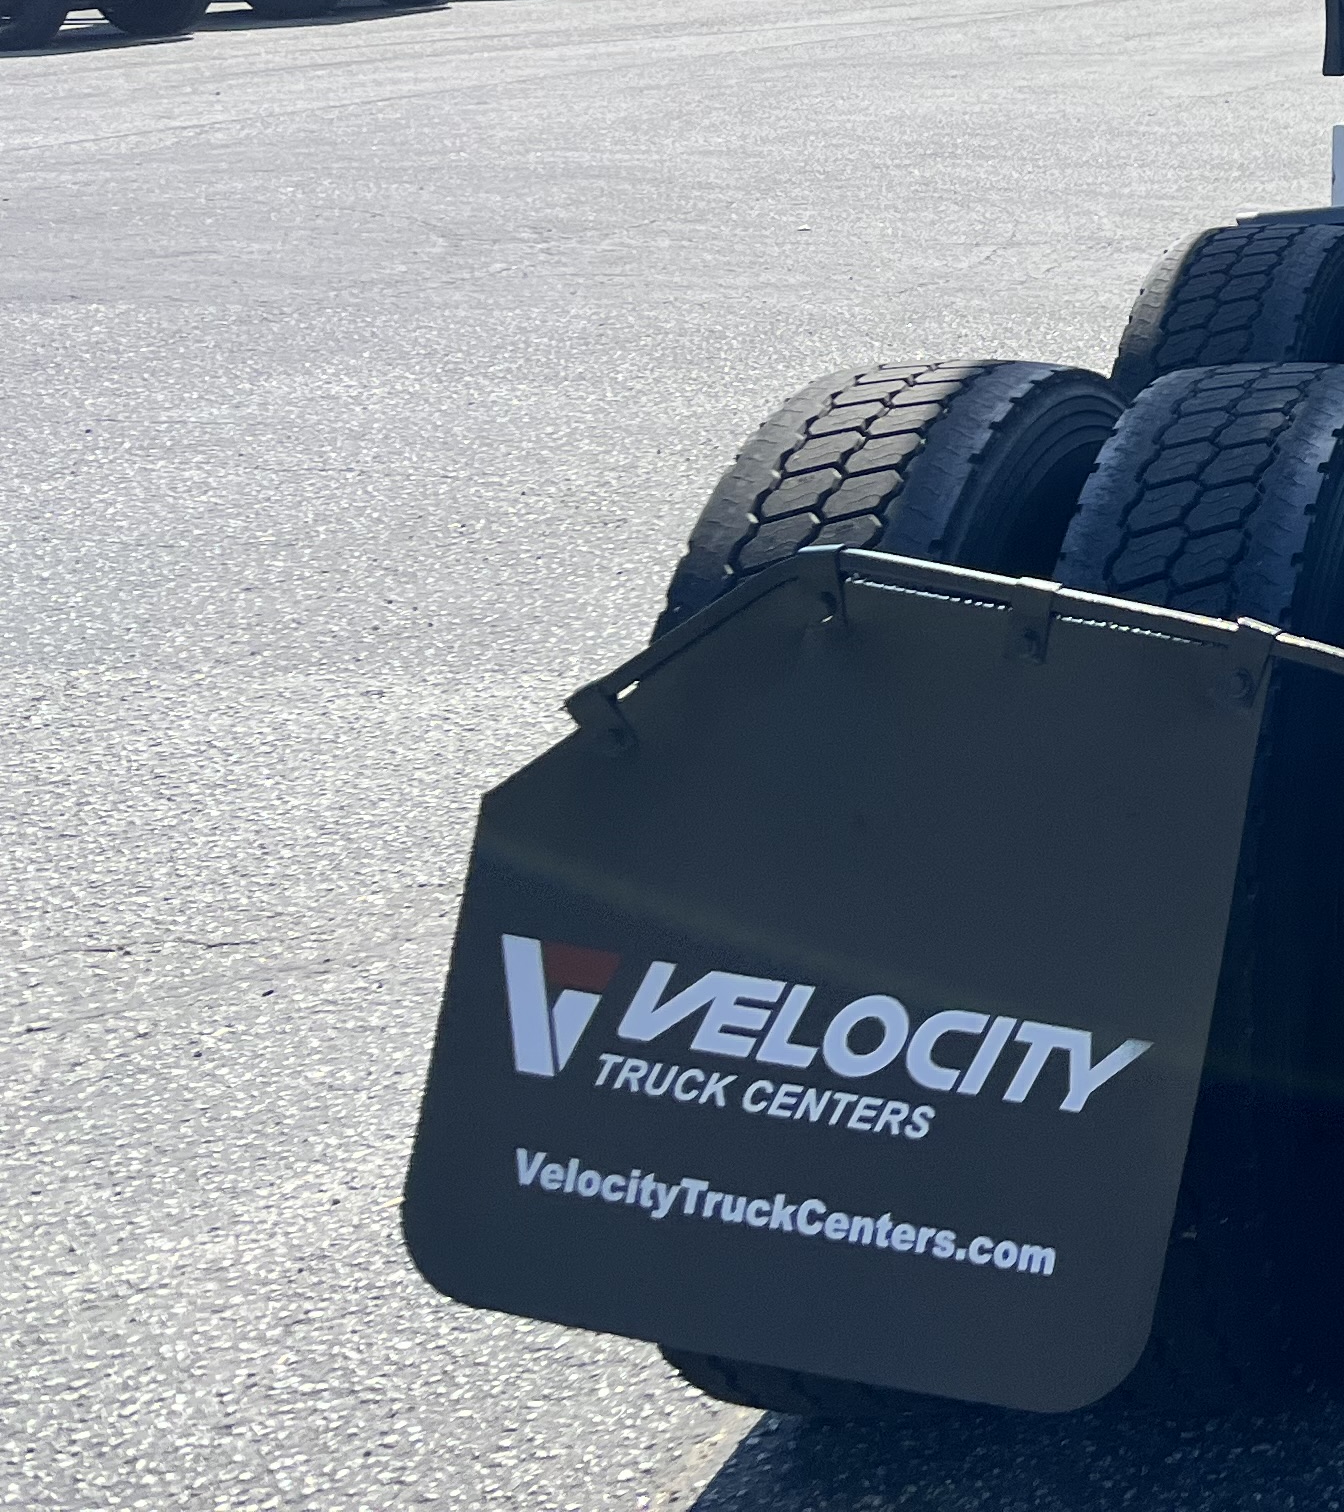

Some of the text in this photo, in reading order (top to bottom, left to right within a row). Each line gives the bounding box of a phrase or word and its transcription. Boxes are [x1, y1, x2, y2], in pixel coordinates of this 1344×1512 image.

[594, 1052, 936, 1140] TRUCK CENTERS
[617, 960, 1154, 1114] VELOCITY
[515, 1147, 1057, 1277] VelocityTruckCenters.com
